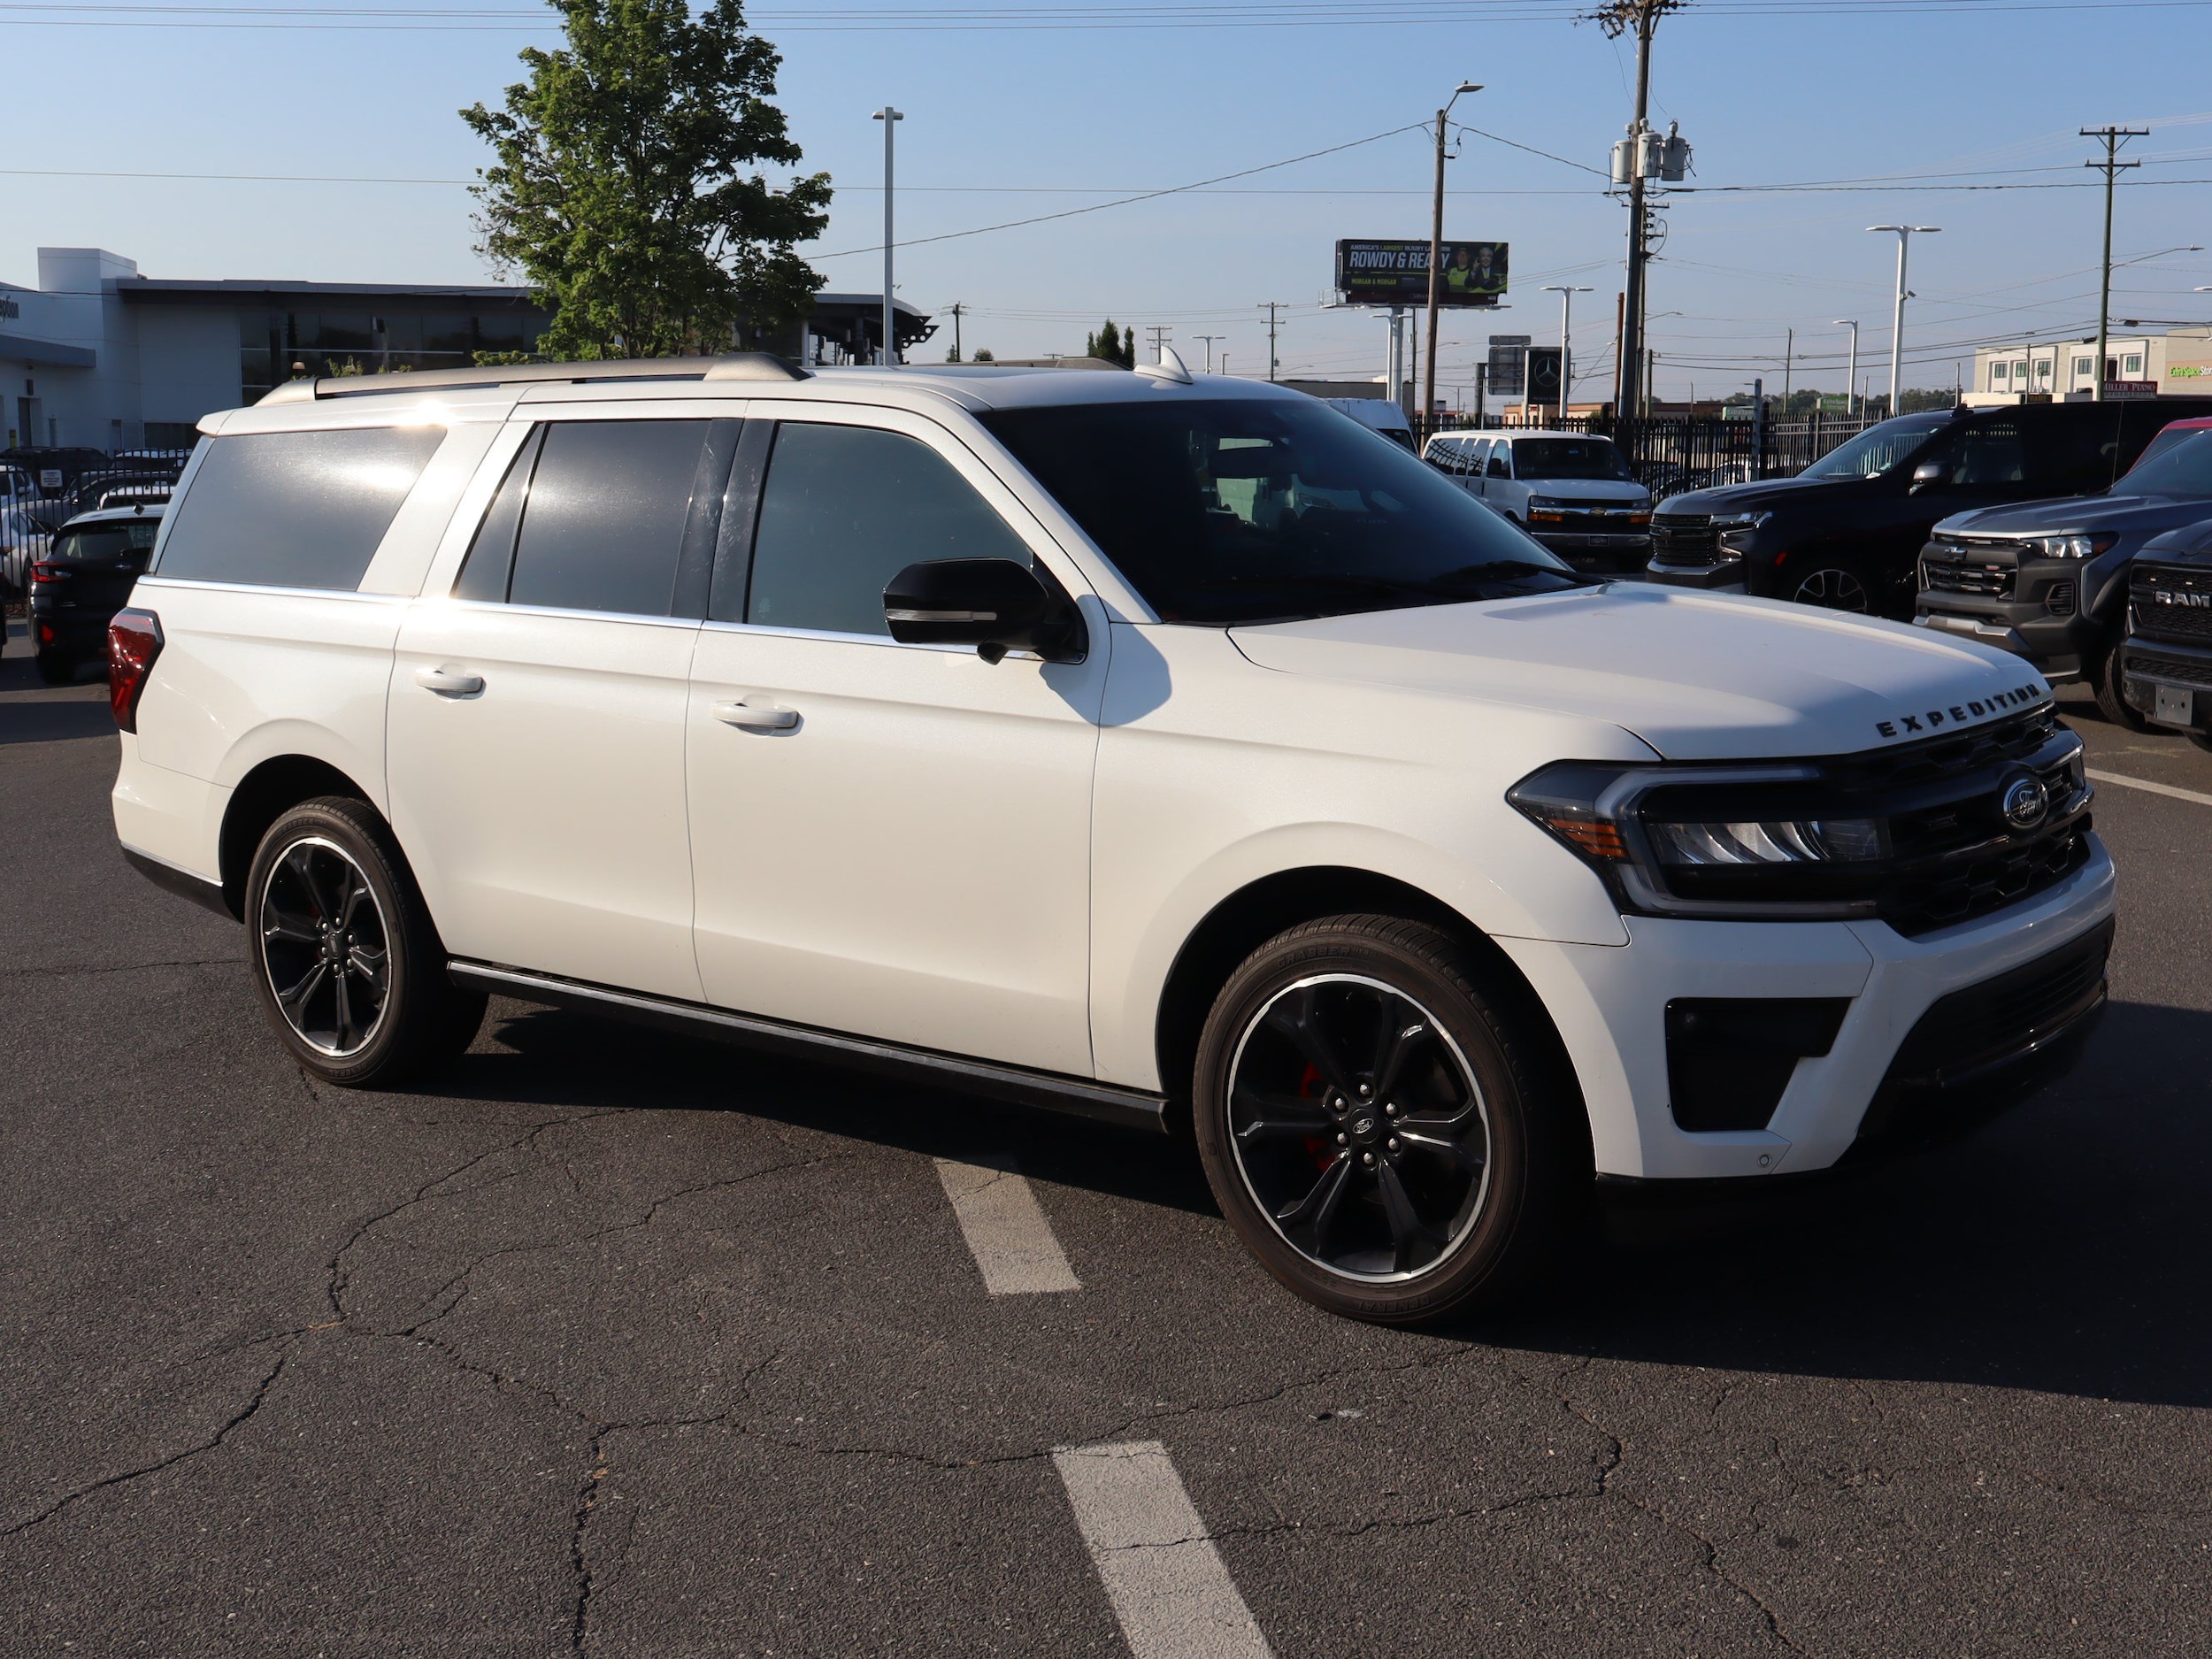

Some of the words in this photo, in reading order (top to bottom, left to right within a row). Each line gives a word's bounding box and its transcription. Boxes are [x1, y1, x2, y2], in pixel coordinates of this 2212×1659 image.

[1349, 251, 1397, 268] ROWDY
[1397, 252, 1407, 268] &
[1409, 252, 1450, 269] REAY
[2131, 382, 2155, 391] PIANO
[2155, 591, 2210, 608] RAM
[1876, 683, 2040, 738] EXPEDITION
[1277, 946, 1351, 968] GRABBER
